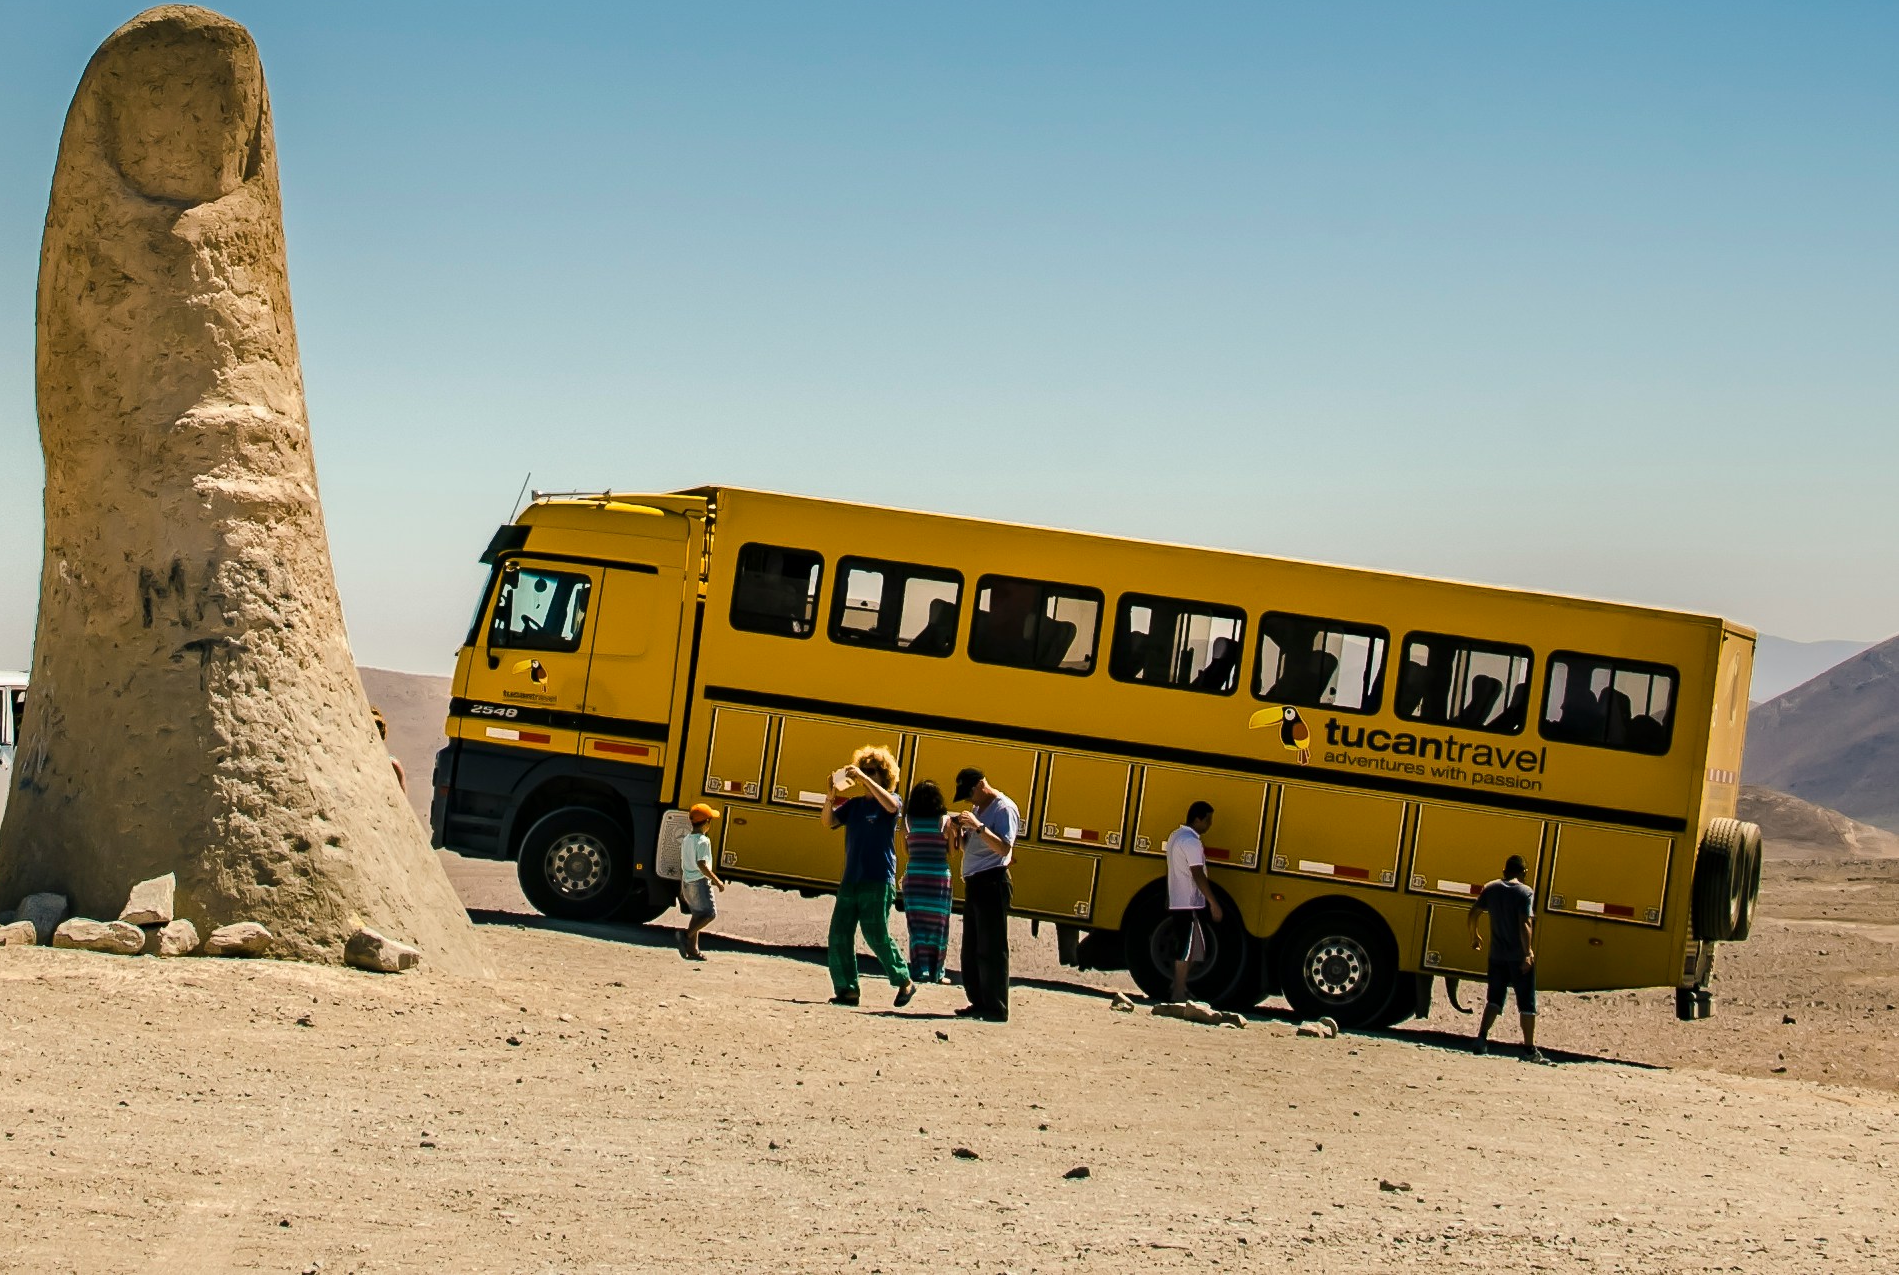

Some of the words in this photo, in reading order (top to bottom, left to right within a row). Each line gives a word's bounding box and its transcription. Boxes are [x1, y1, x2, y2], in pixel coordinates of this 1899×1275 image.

[1325, 718, 1547, 774] tucantravel
[1323, 750, 1425, 776] adventures
[1430, 764, 1467, 782] with
[1471, 771, 1543, 792] passion
